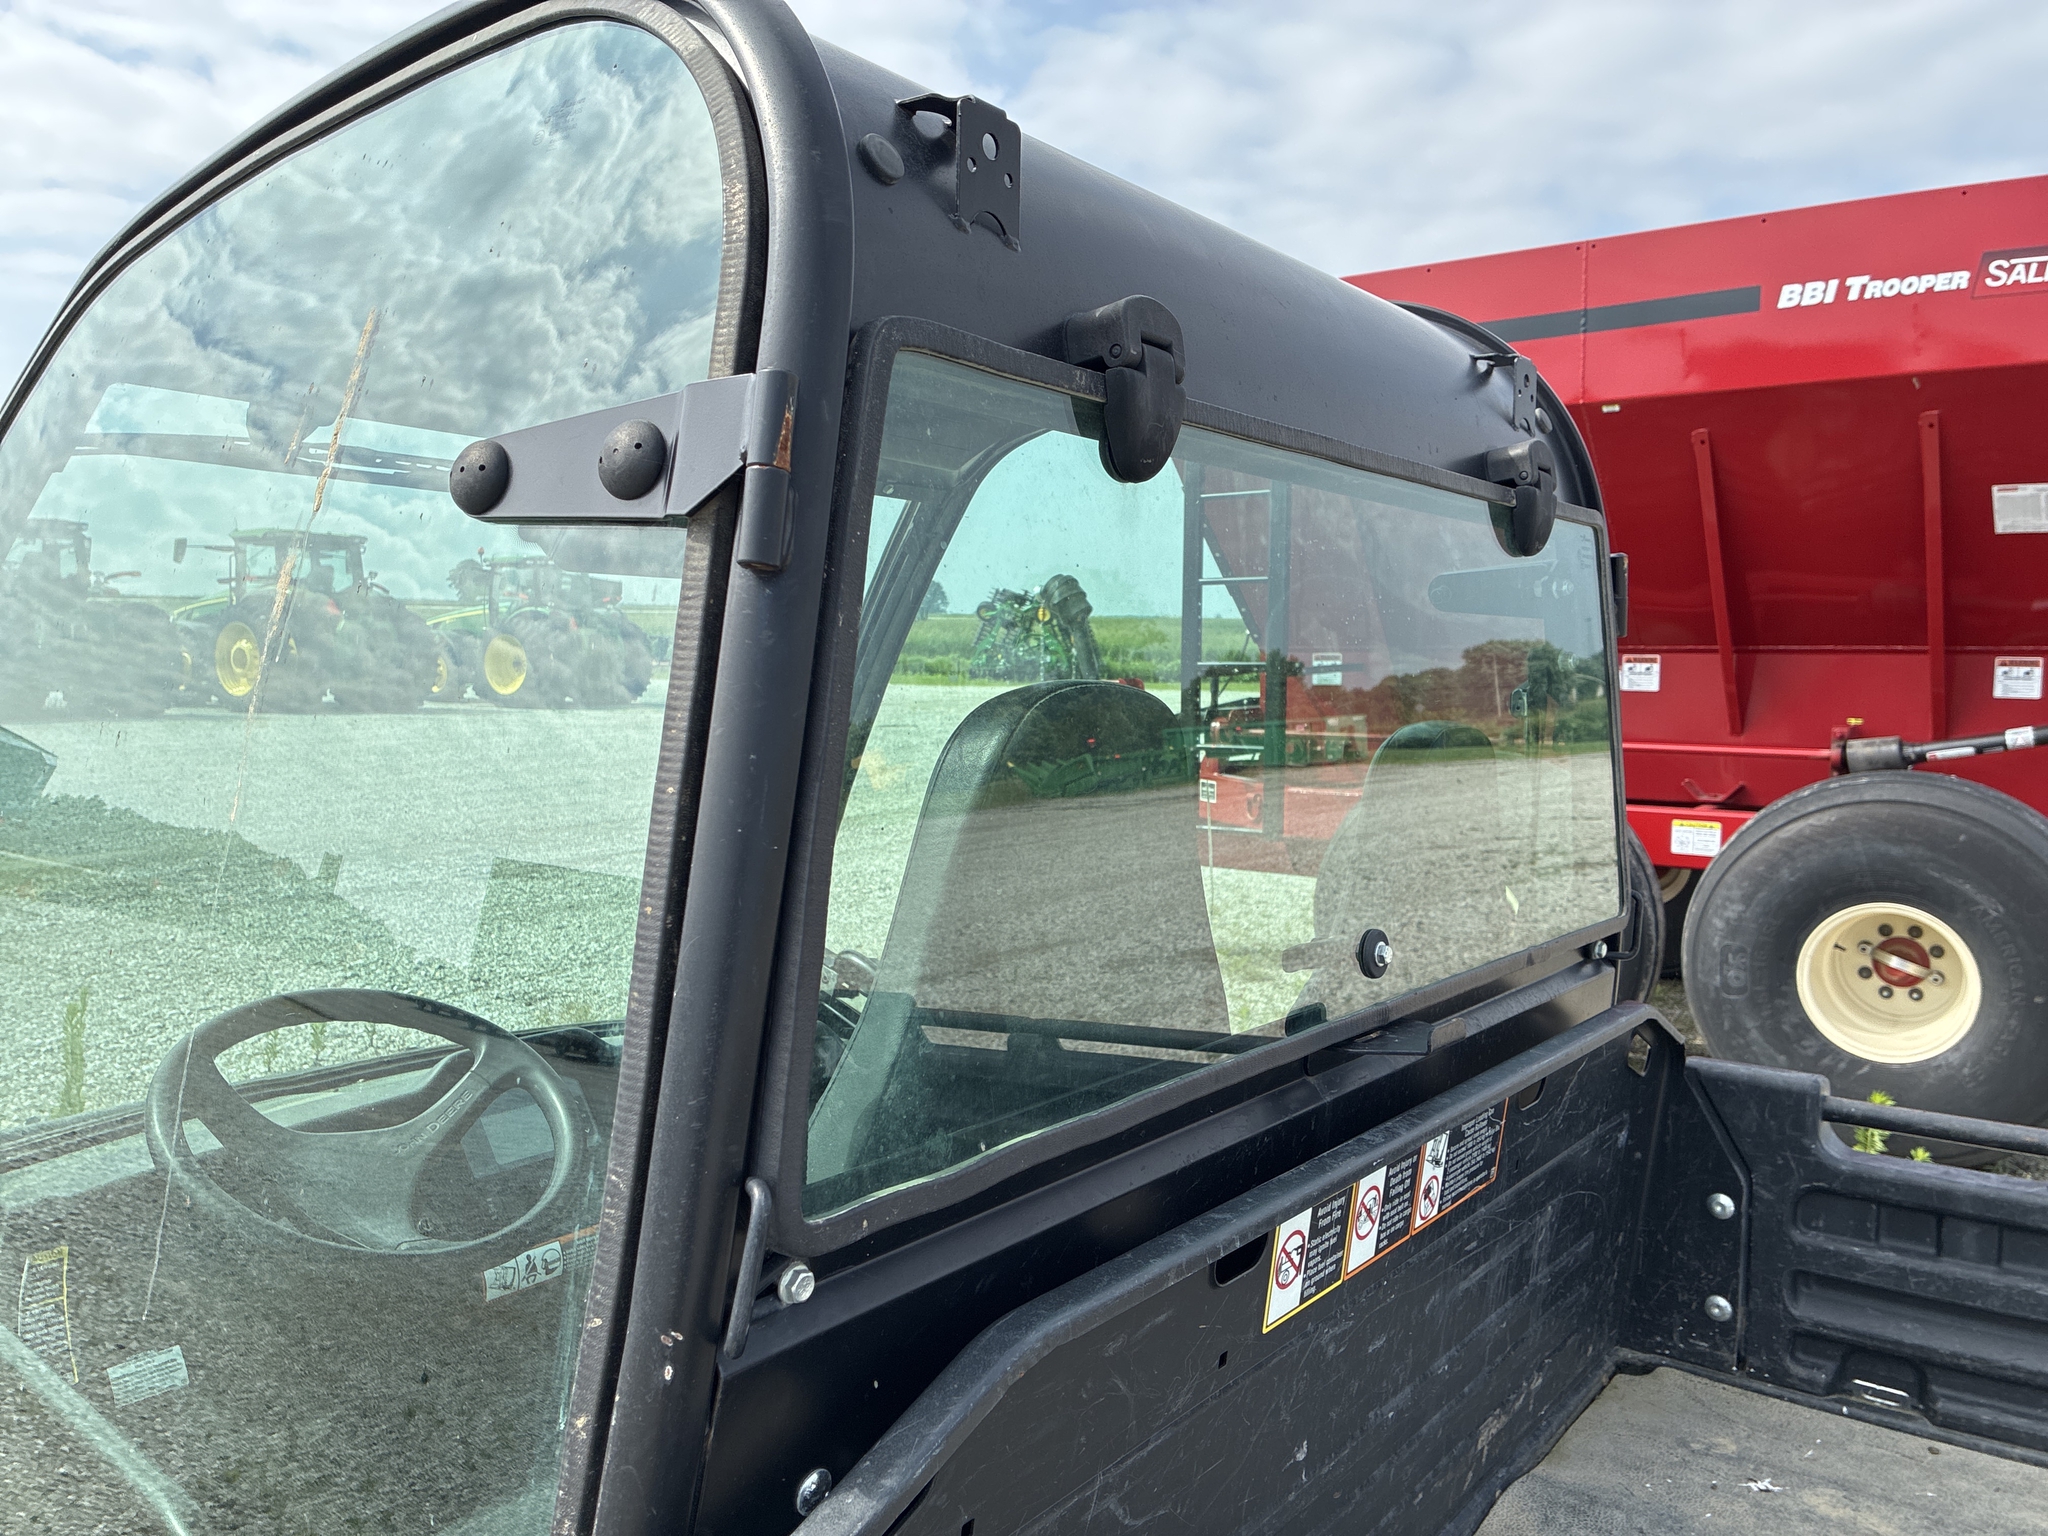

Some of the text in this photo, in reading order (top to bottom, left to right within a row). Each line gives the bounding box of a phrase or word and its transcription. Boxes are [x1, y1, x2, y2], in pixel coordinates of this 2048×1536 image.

[1776, 270, 1971, 310] BBI TROOPER
[426, 1089, 473, 1133] DEERE
